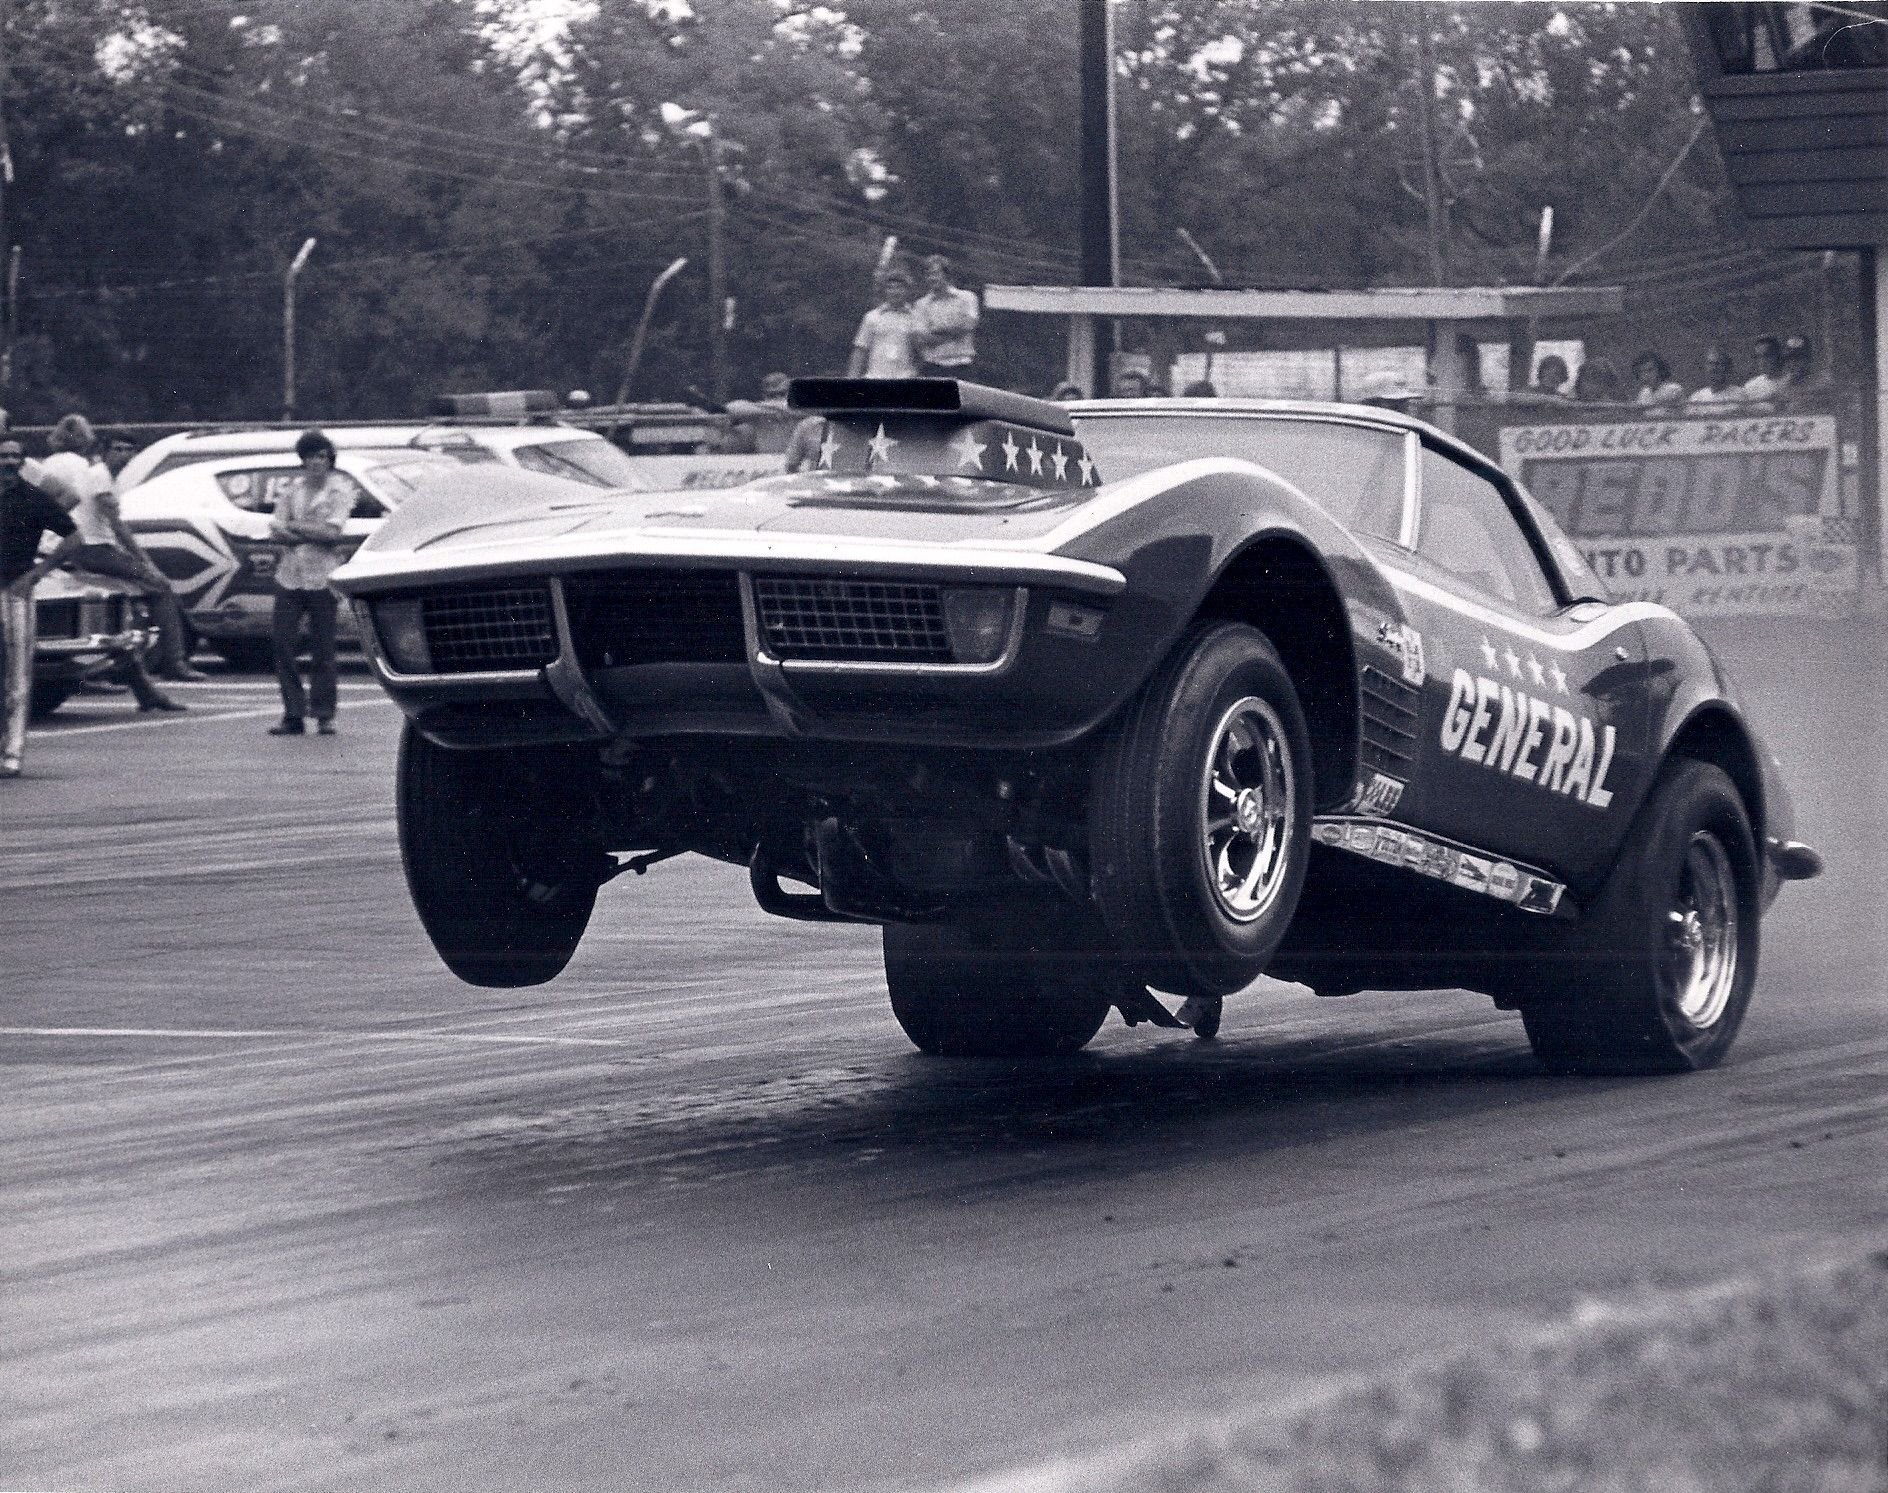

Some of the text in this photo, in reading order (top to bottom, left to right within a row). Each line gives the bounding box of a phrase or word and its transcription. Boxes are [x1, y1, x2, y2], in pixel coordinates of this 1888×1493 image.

[1513, 419, 1816, 453] GOOD LUCK RACERS
[1666, 544, 1798, 575] PARTS
[1441, 668, 1615, 808] GENERAL
